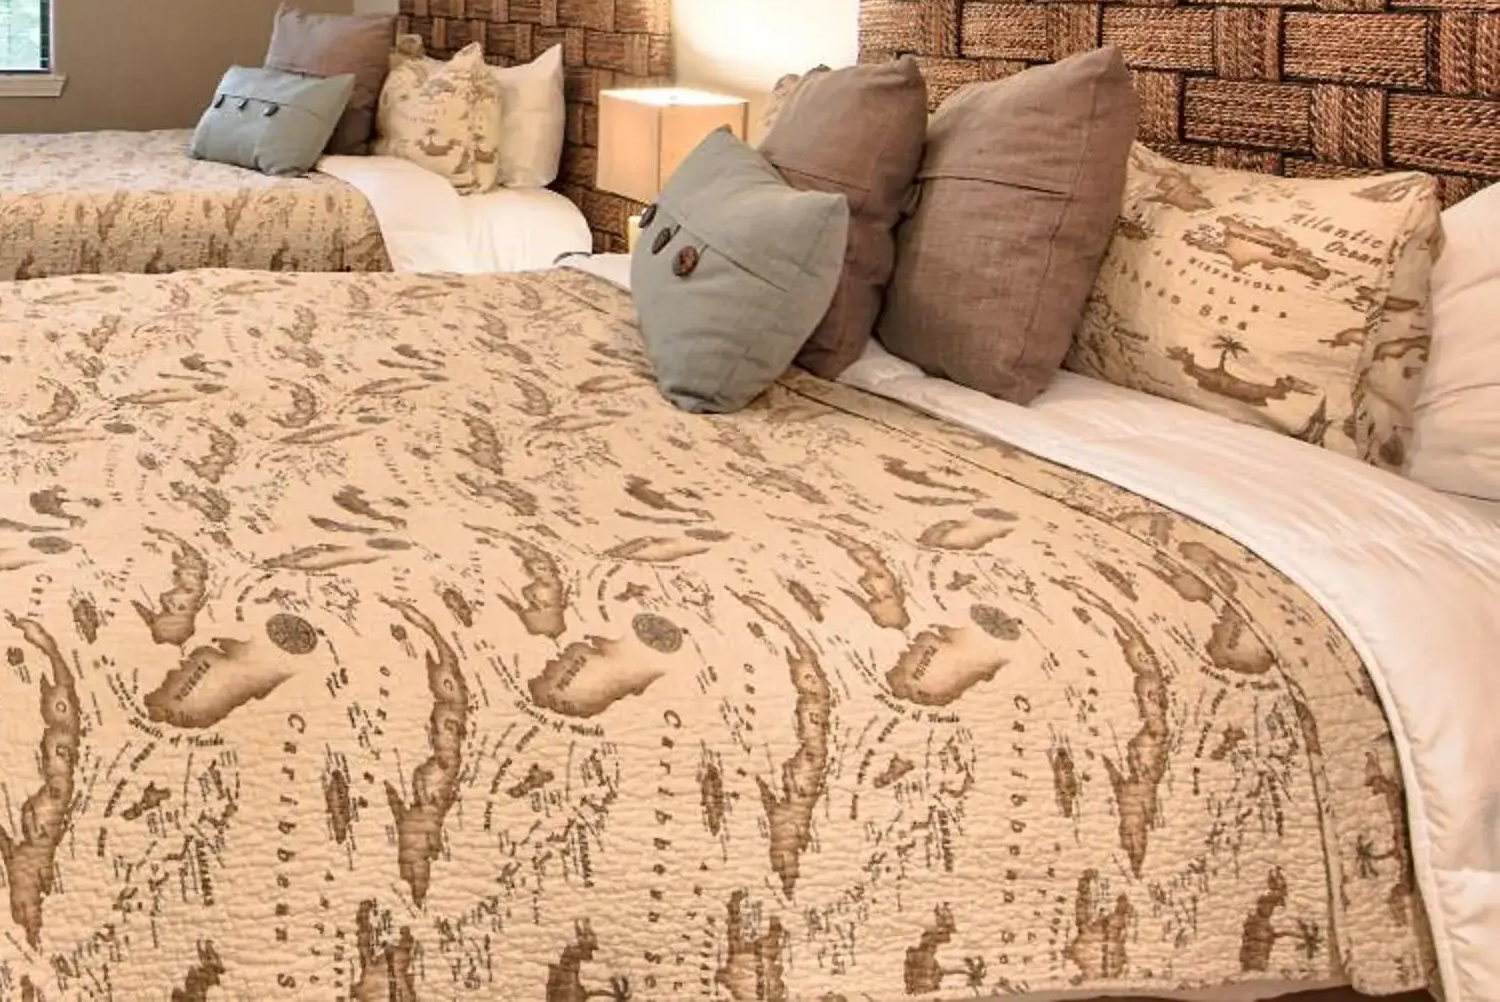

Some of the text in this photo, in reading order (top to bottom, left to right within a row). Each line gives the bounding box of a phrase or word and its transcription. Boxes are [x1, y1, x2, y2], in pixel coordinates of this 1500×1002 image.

[1286, 213, 1384, 249] Atlantic
[1324, 240, 1383, 266] Ocean
[276, 713, 307, 942] Caribbean
[647, 709, 682, 923] Caribbean
[1002, 694, 1031, 903] Caribbean
